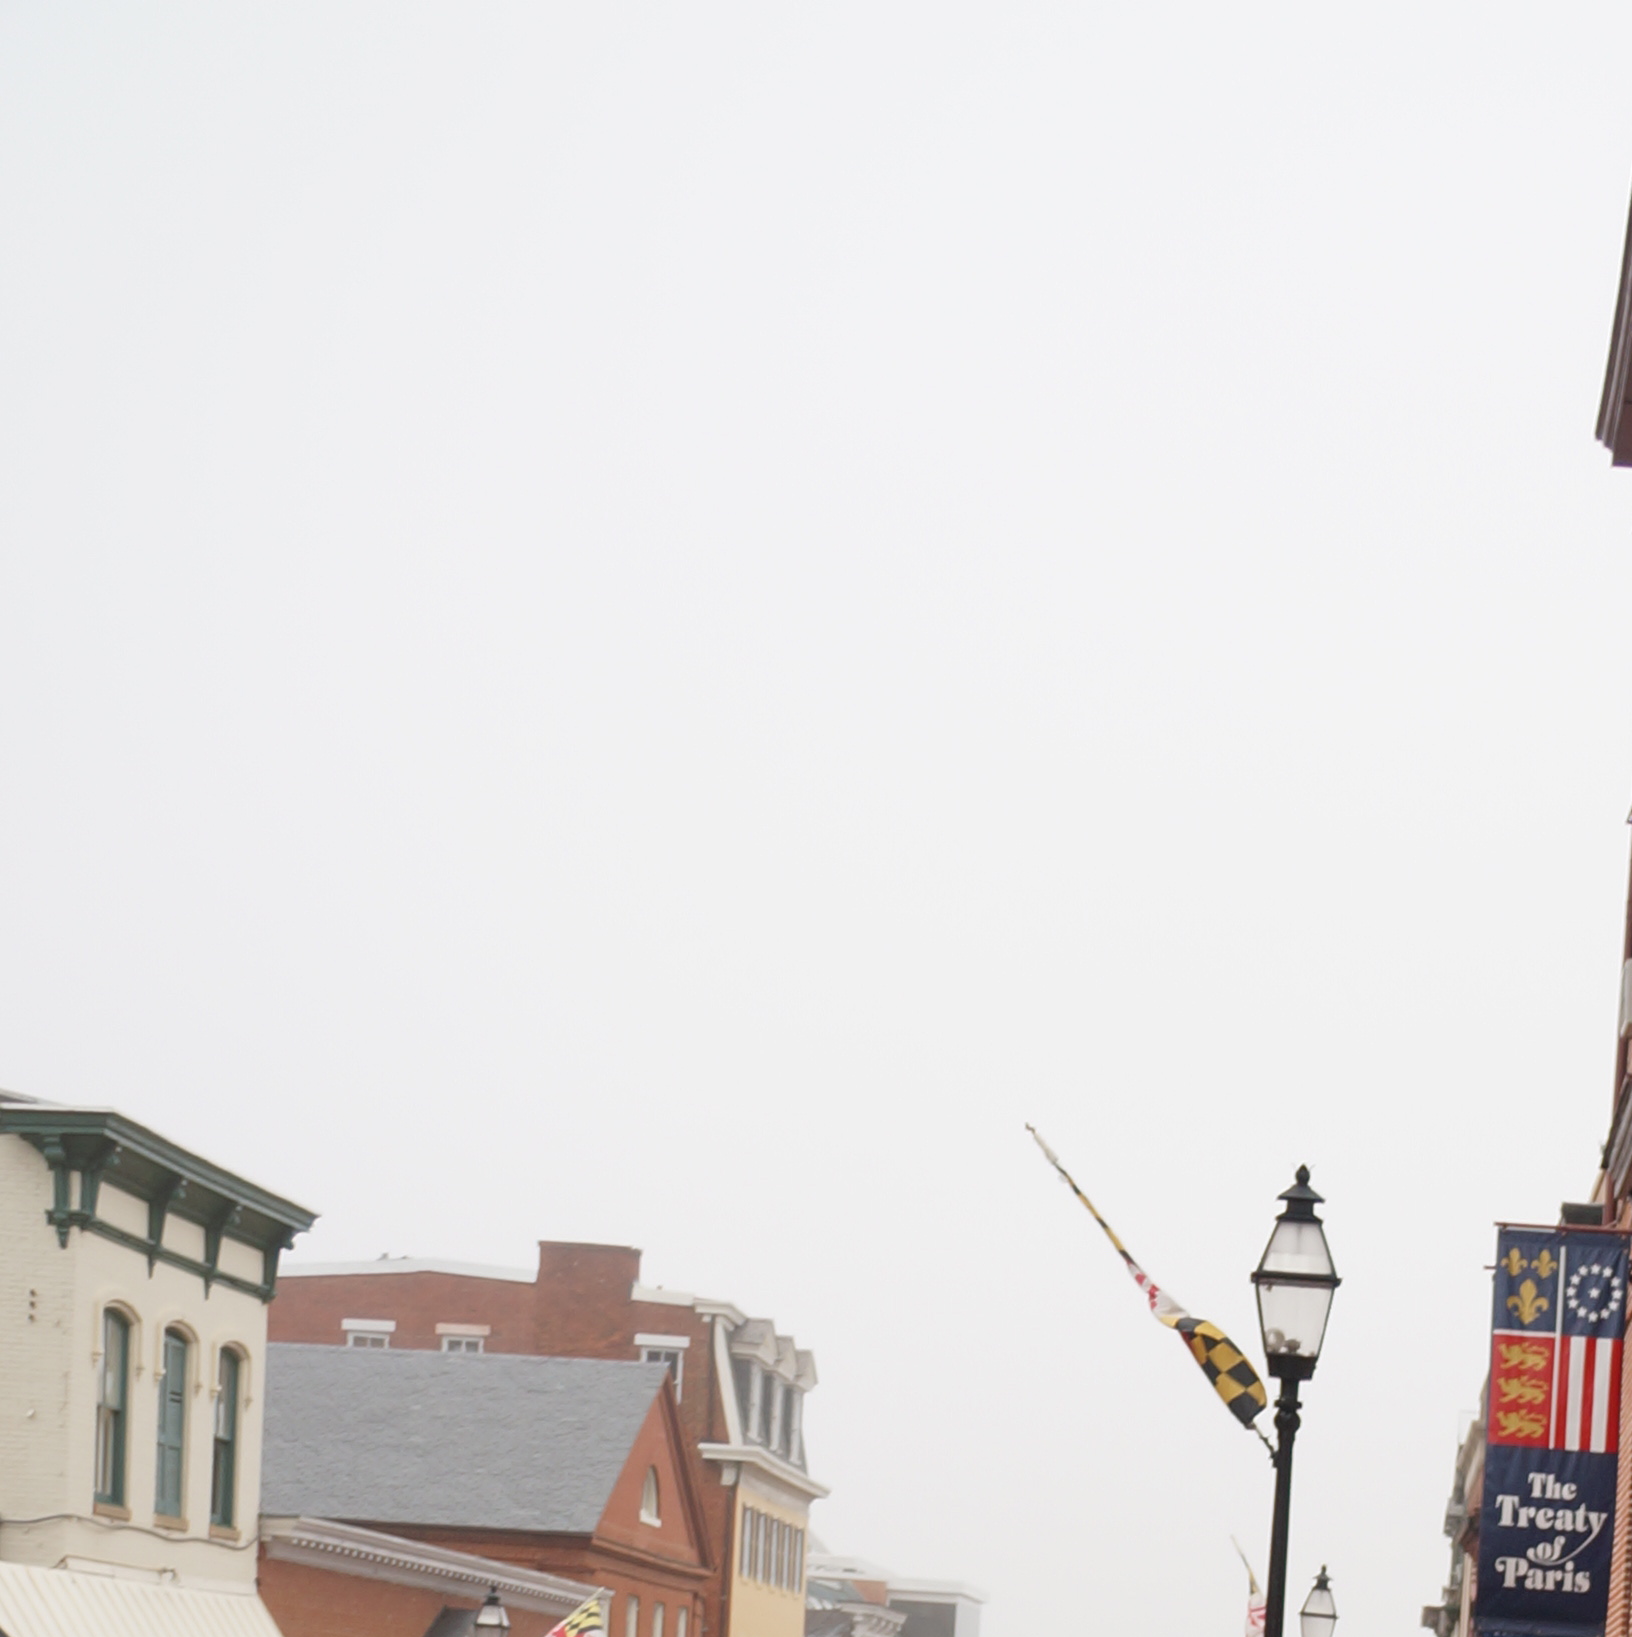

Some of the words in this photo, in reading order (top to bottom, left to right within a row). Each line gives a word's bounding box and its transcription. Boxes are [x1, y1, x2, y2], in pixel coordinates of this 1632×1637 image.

[1528, 1471, 1577, 1501] The
[1495, 1494, 1608, 1546] Treaty
[1526, 1535, 1566, 1566] of
[1495, 1556, 1590, 1593] Paris
